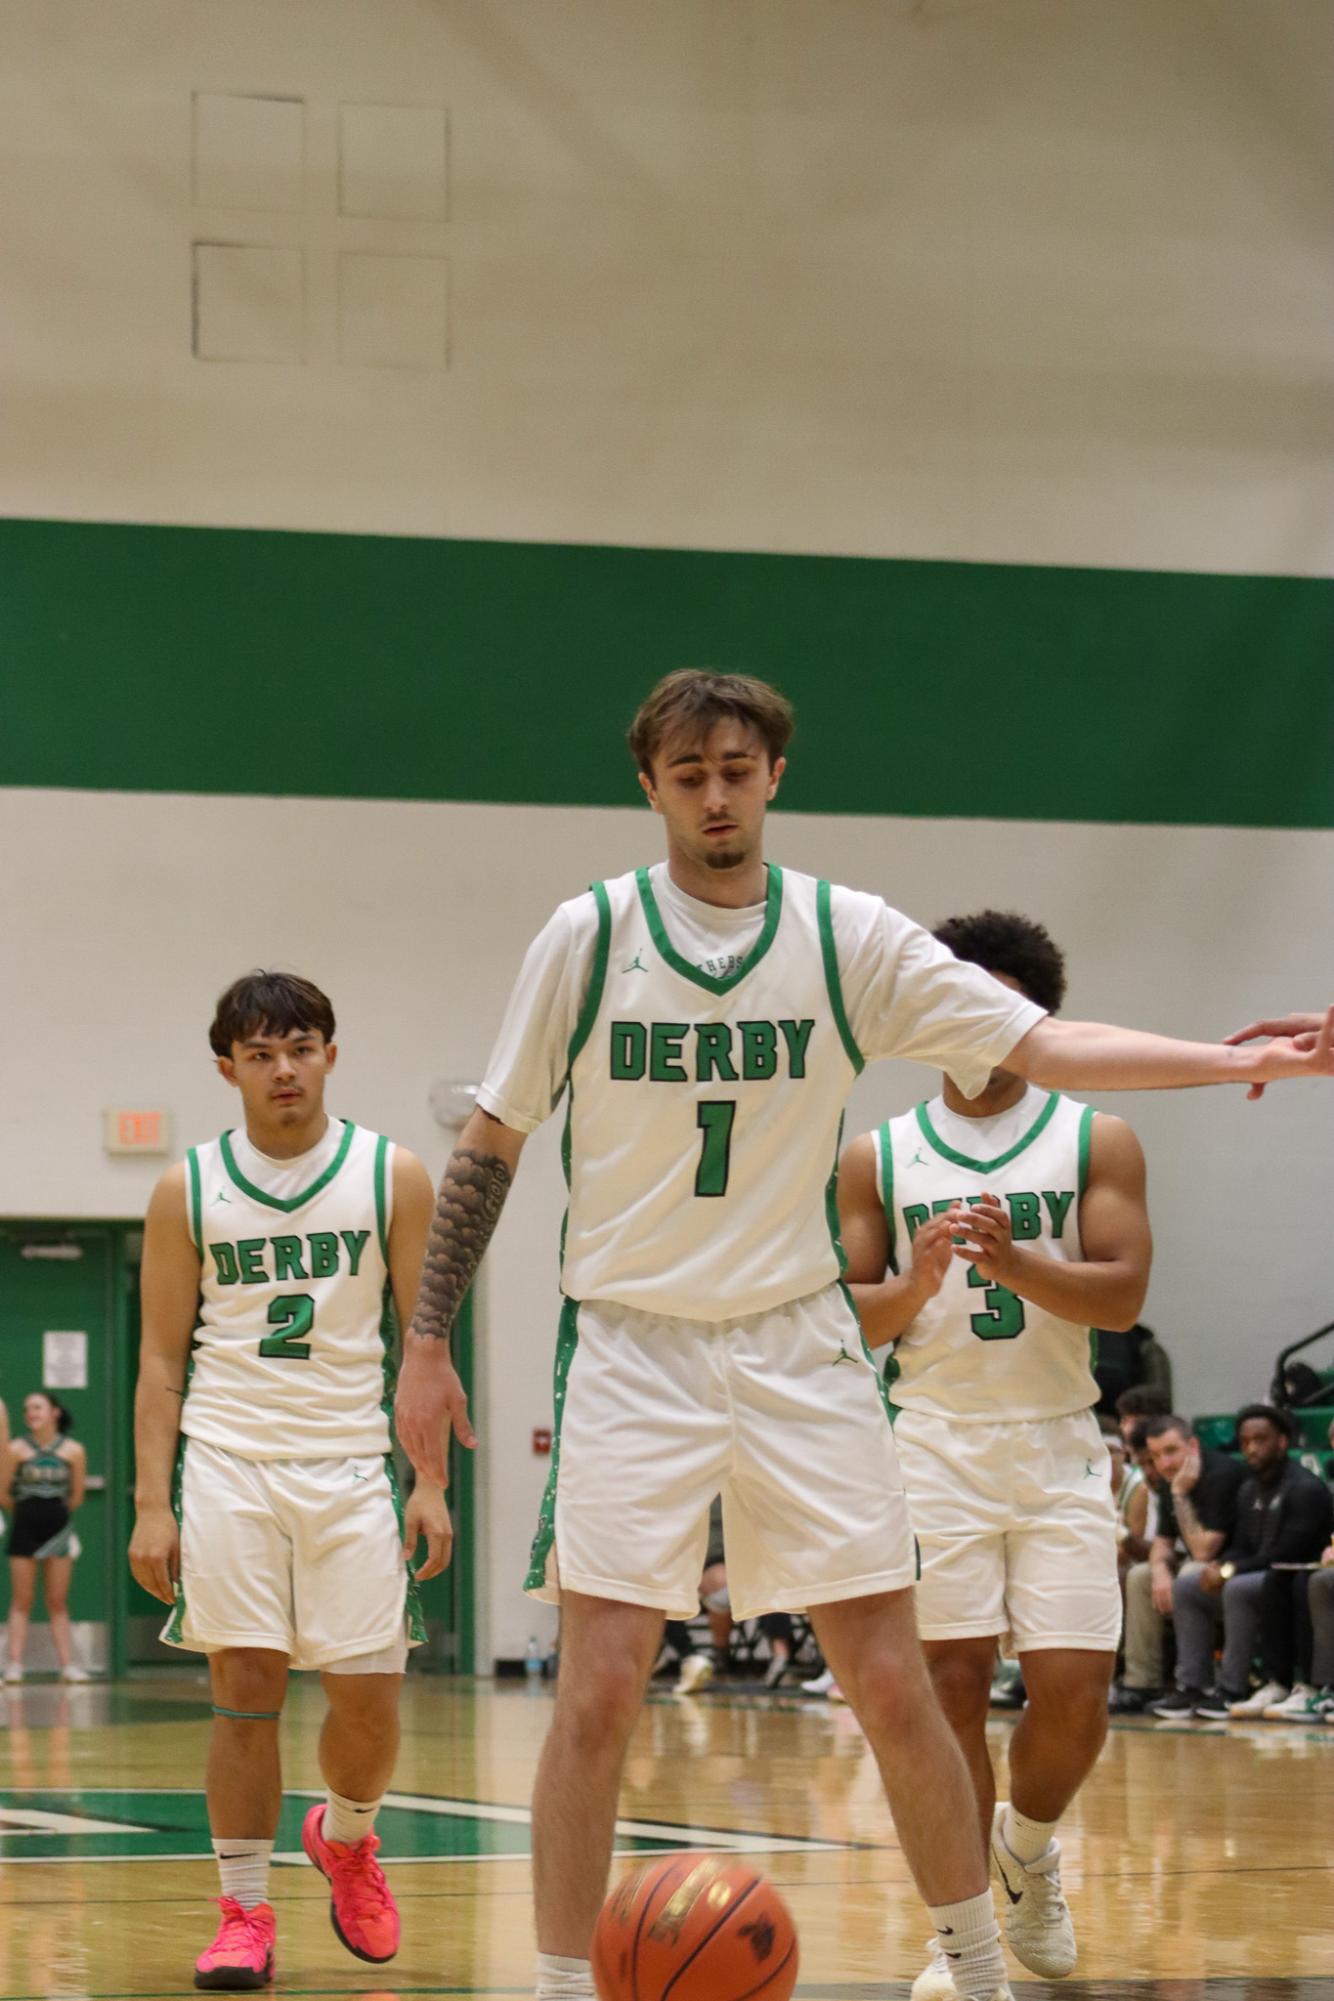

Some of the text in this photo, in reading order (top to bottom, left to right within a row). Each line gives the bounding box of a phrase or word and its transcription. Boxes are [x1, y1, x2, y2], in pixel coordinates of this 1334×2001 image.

[610, 1019, 815, 1082] DERBY
[694, 1100, 736, 1197] 1
[209, 1230, 371, 1285] DERBY
[259, 1294, 315, 1360] 2
[967, 1262, 1026, 1341] 3
